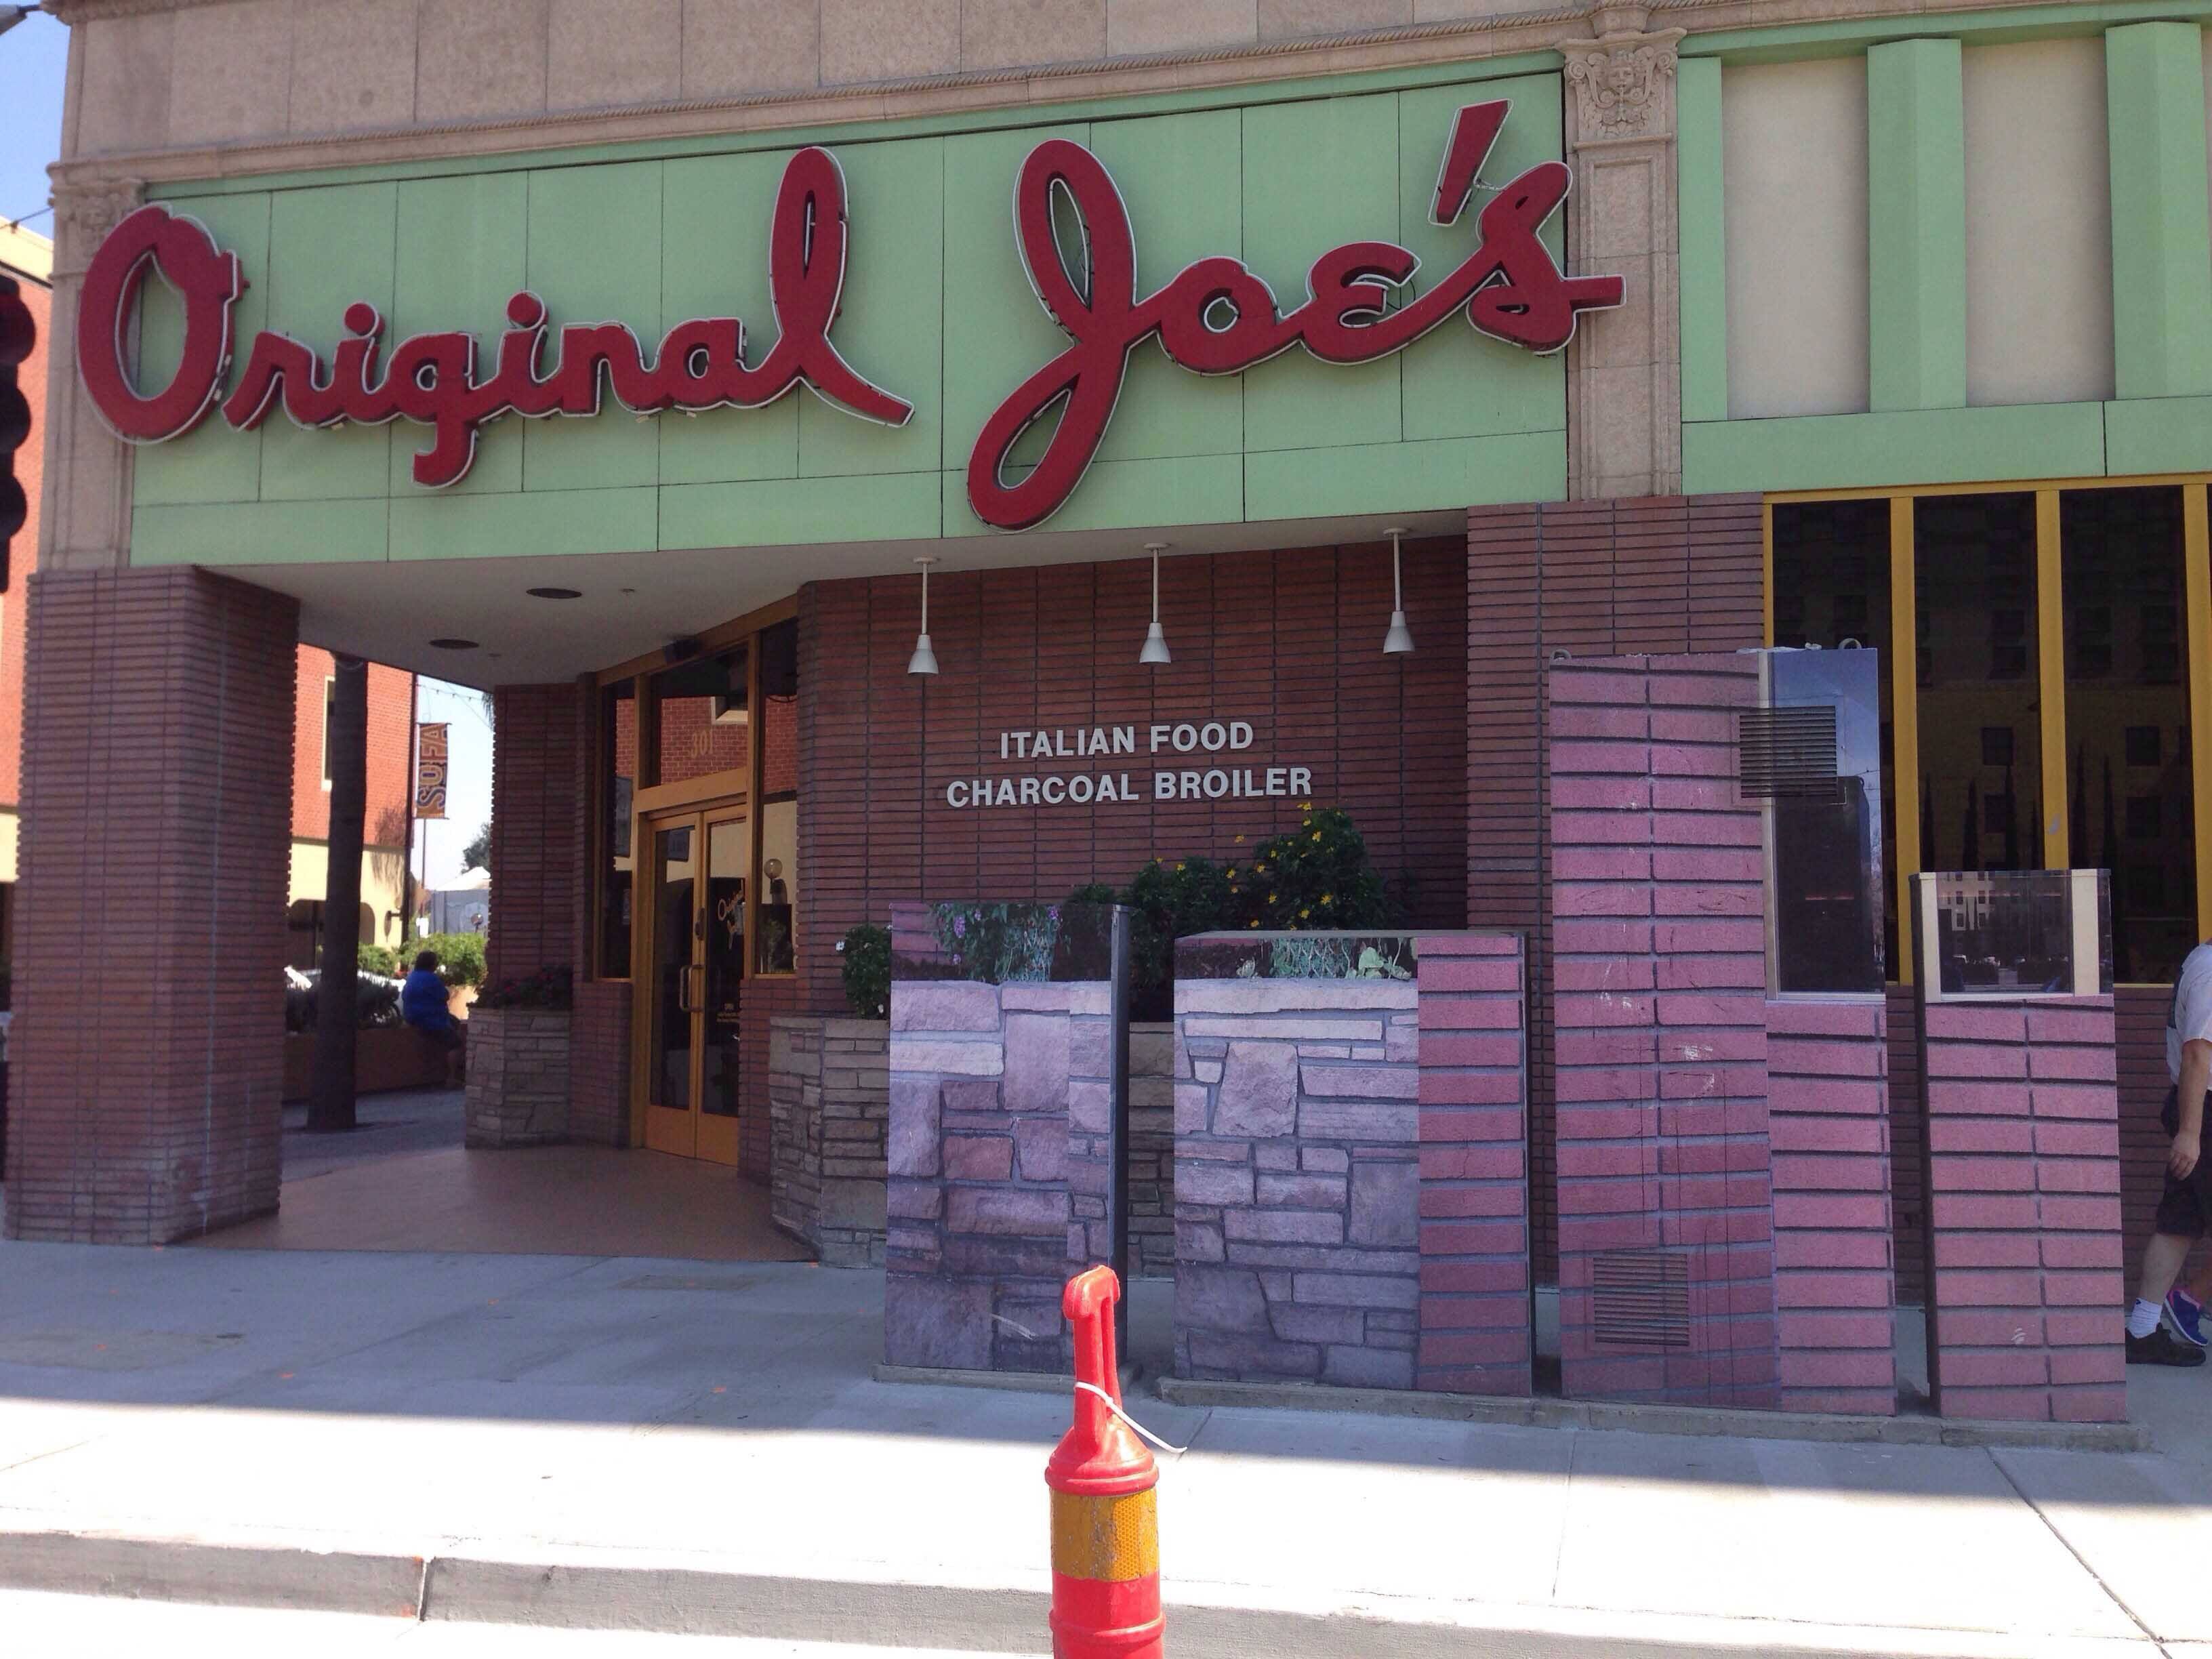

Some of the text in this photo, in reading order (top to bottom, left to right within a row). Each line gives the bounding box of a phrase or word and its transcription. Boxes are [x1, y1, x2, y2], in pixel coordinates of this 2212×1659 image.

[77, 98, 1626, 534] Original Joe's
[690, 731, 715, 758] 301
[1000, 722, 1253, 759] ITALIAN FOOD
[416, 724, 448, 808] SOFA
[946, 767, 1312, 808] CHARCOAL BROILER
